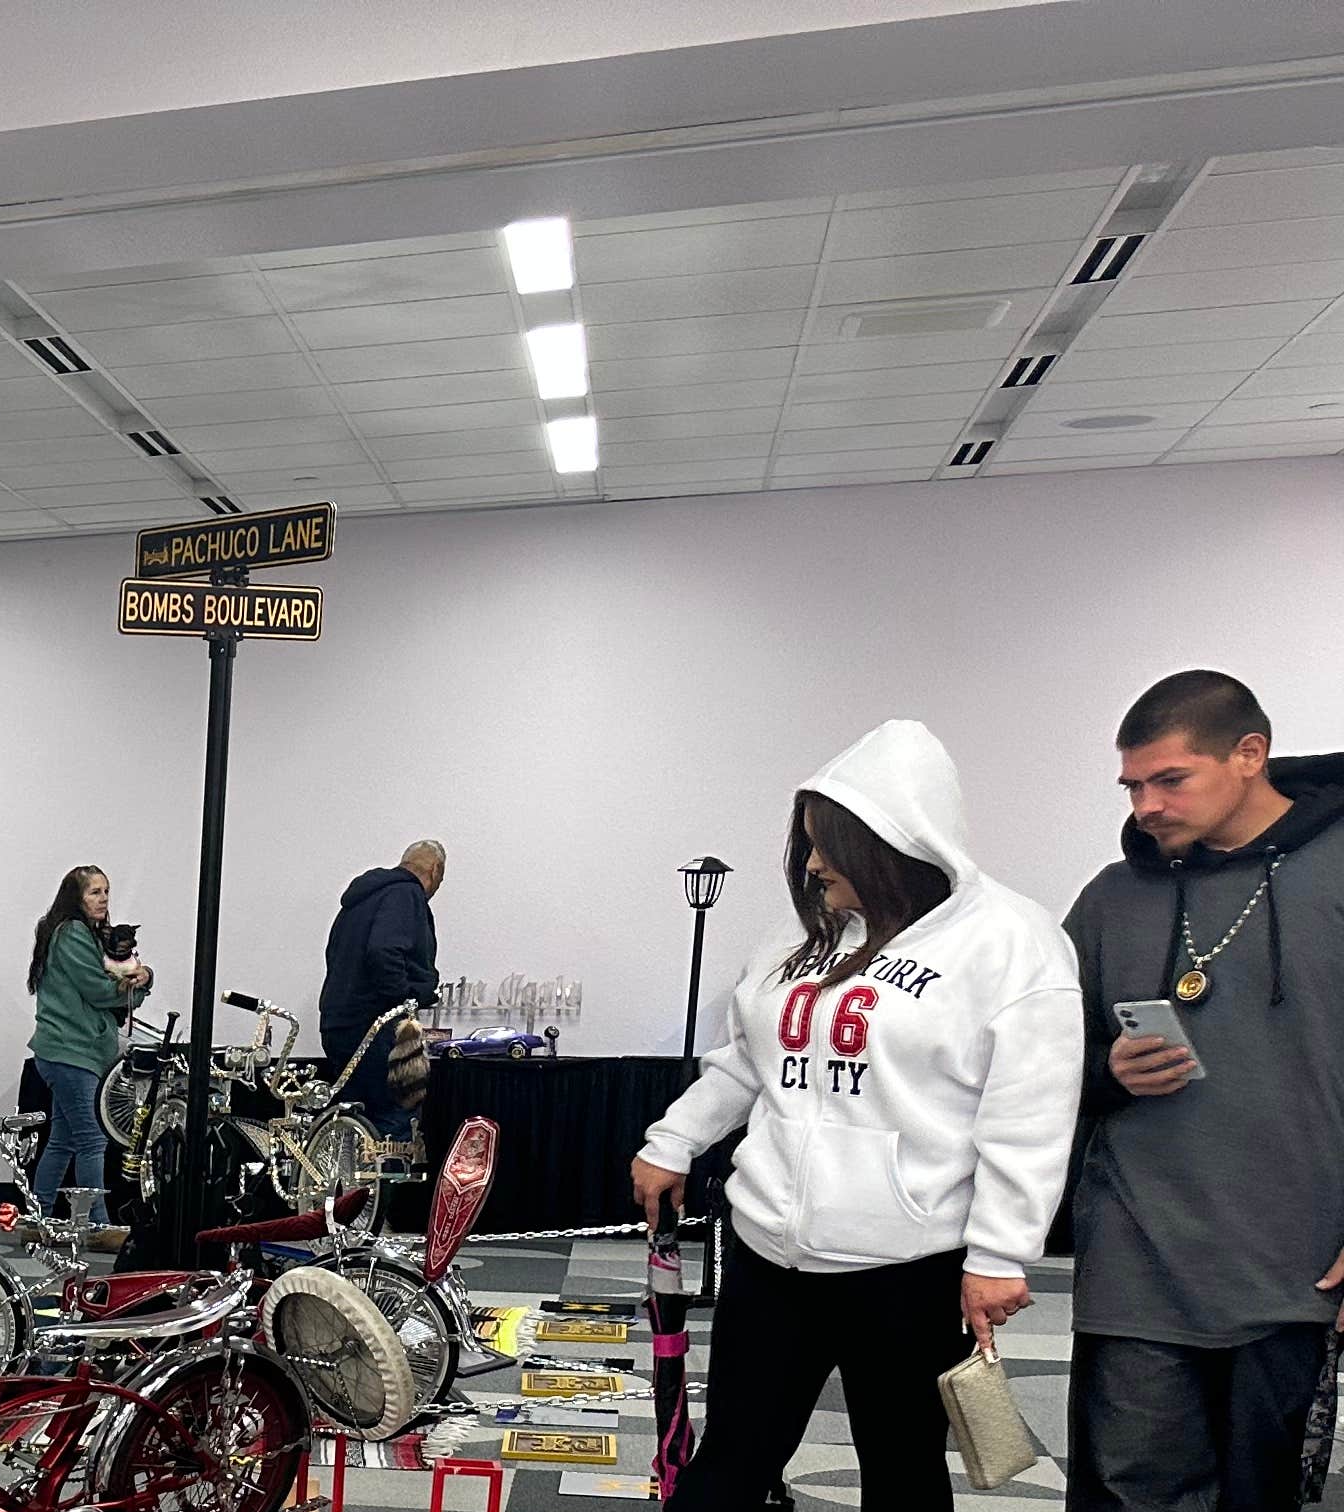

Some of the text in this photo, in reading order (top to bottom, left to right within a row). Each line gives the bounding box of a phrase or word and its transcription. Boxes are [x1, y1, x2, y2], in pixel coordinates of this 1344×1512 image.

[171, 526, 260, 567] PACHUCO
[269, 516, 324, 555] LANE
[125, 591, 317, 629] BOMBS BOULEVARD
[857, 954, 943, 999] YORK
